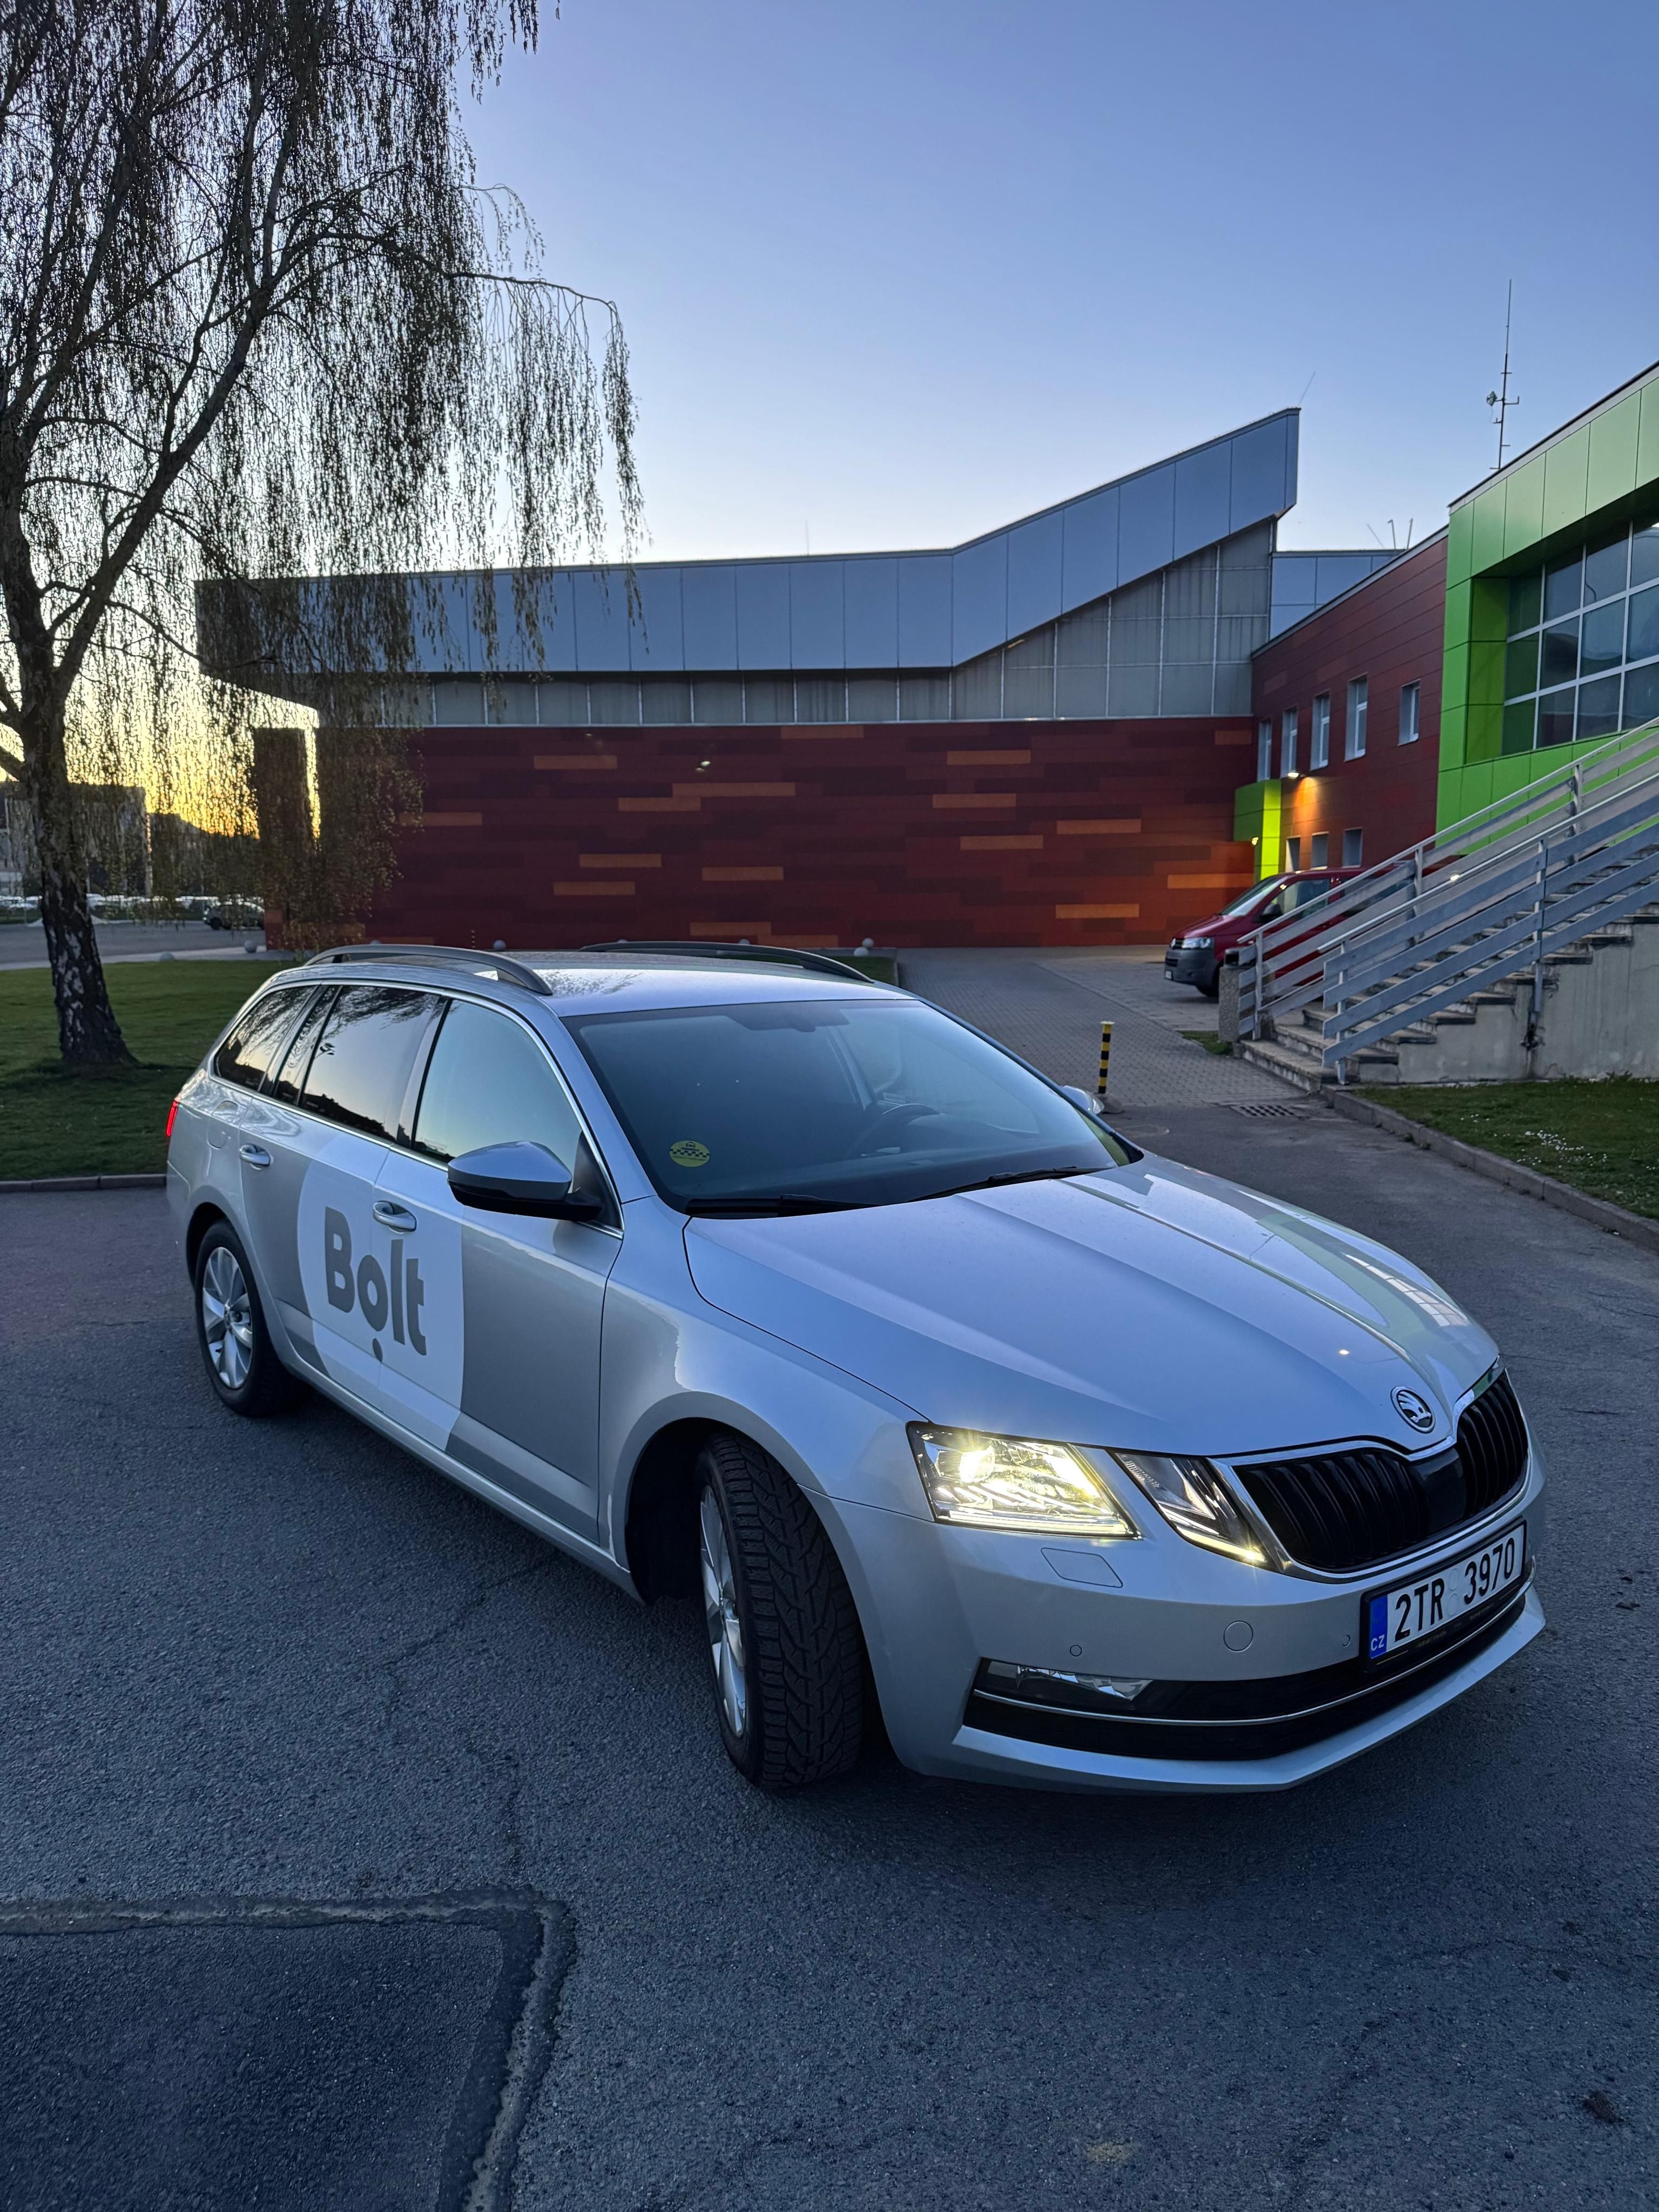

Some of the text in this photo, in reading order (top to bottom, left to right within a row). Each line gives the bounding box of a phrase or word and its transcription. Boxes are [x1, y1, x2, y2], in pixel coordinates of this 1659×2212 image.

[325, 1206, 427, 1362] Bolt
[1395, 1537, 1515, 1642] 2TR 3970
[1371, 1634, 1385, 1651] CZ
